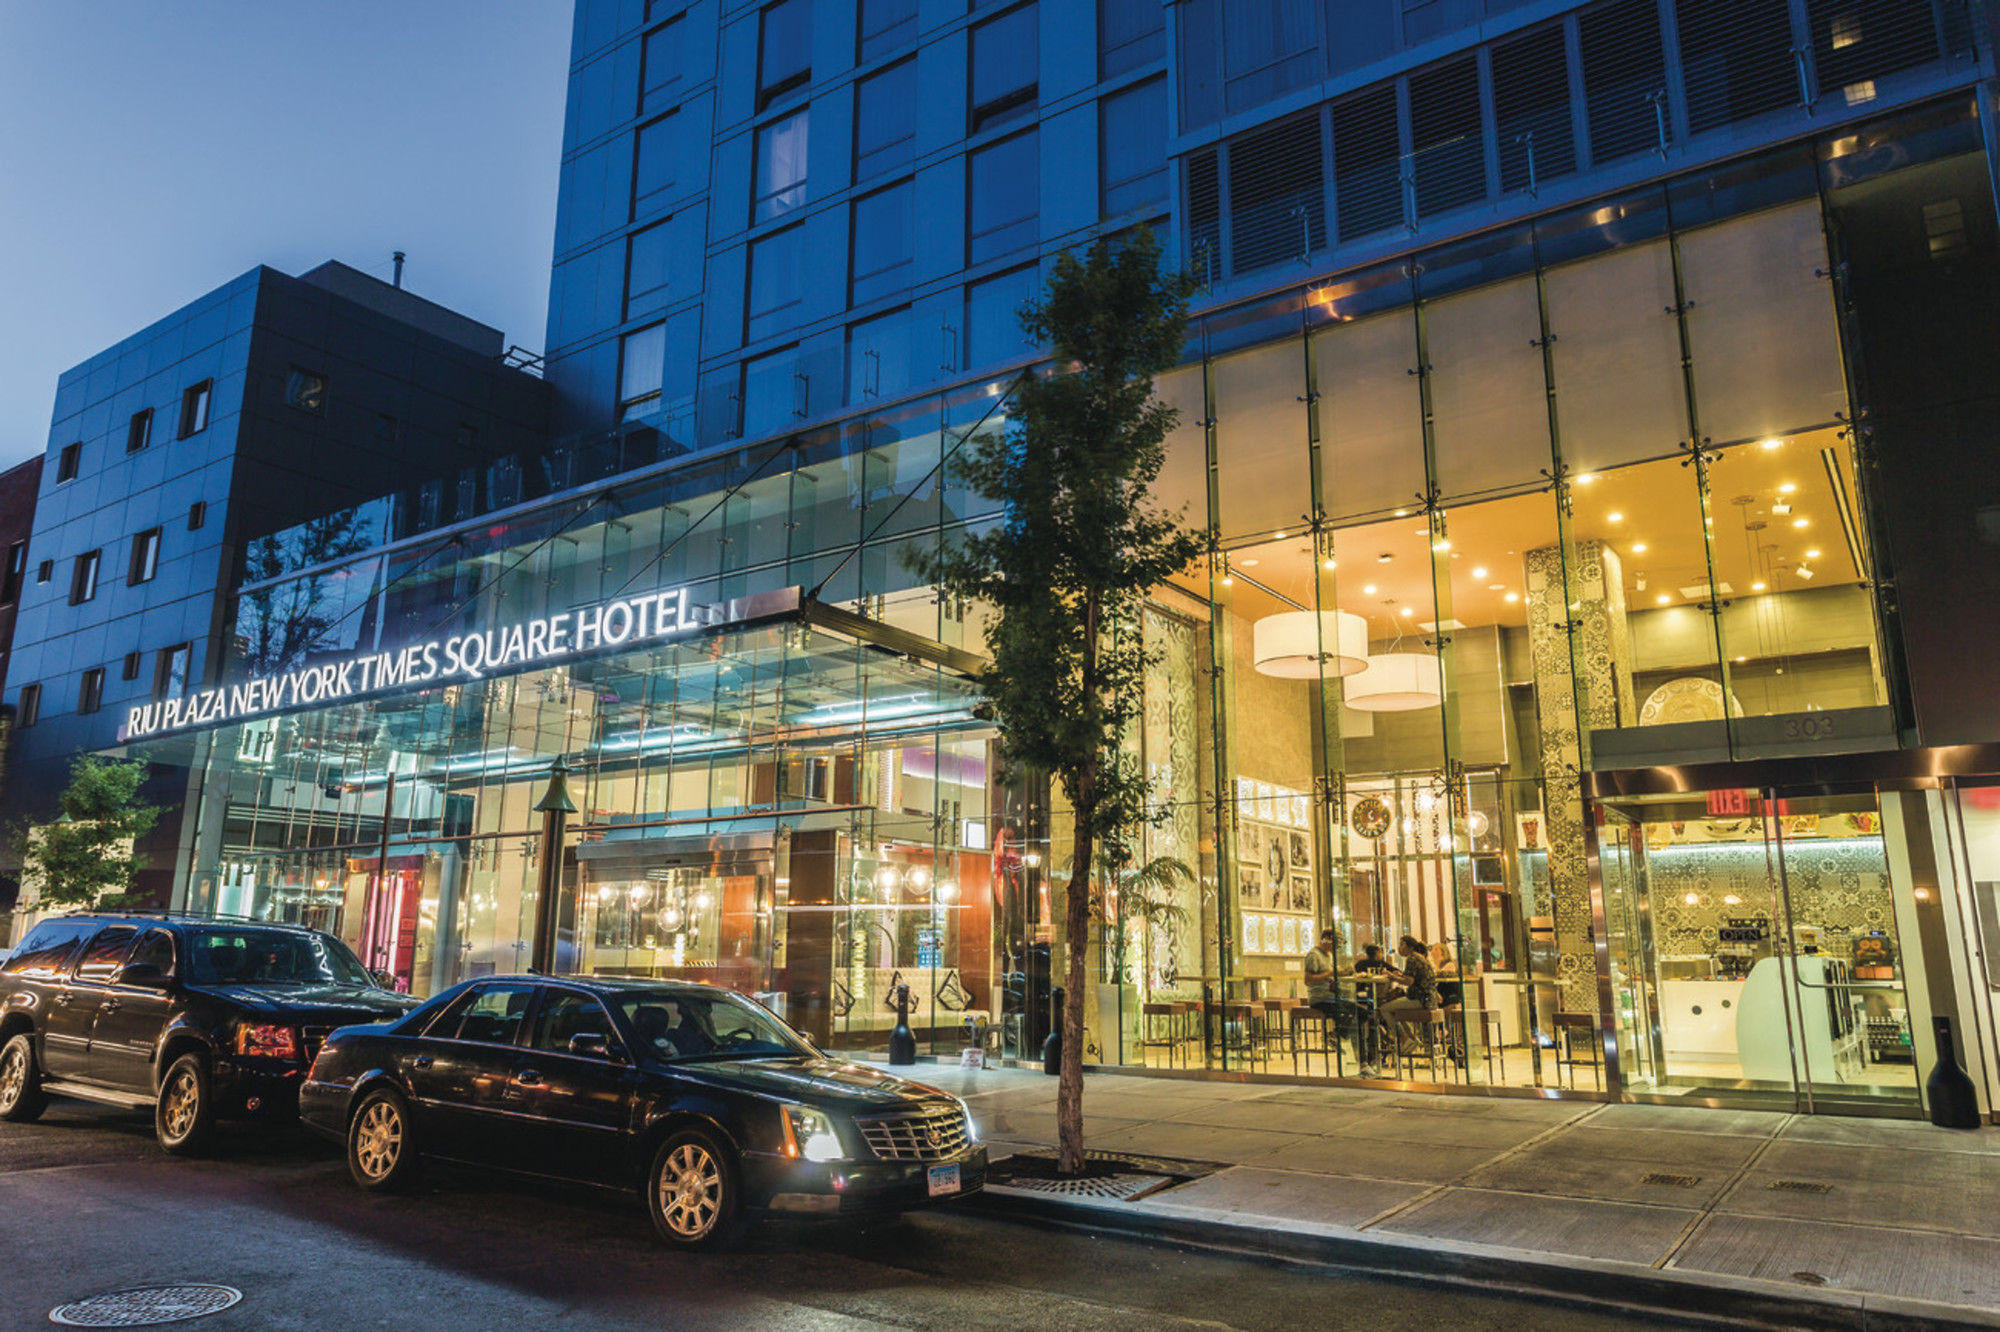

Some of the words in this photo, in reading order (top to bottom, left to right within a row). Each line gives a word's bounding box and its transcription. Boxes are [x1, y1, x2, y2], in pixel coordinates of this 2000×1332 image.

[126, 701, 162, 738] RIU
[162, 687, 227, 731] PLAZA
[229, 673, 289, 717] NEW
[289, 659, 355, 706] YORK
[356, 640, 440, 692] TIMES
[442, 612, 571, 679] SQUARE
[575, 586, 699, 651] HOTEL
[1784, 715, 1835, 738] 303
